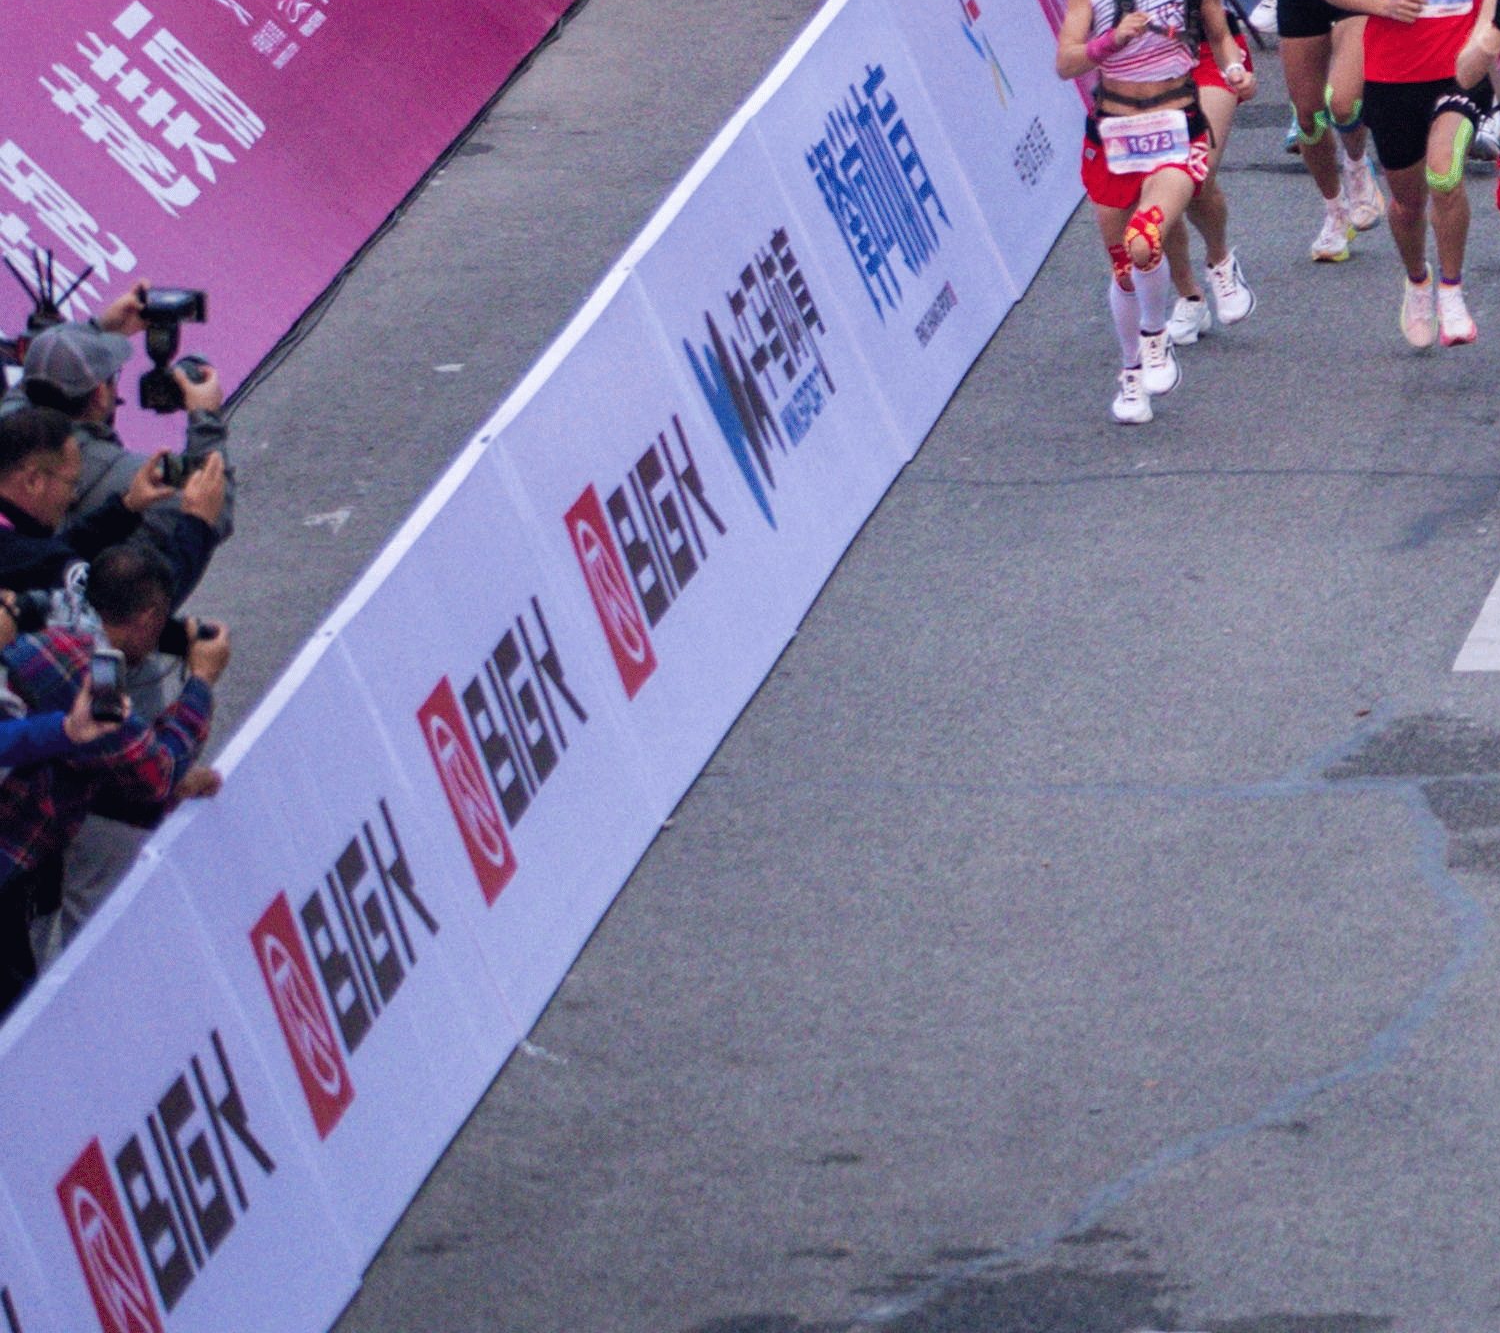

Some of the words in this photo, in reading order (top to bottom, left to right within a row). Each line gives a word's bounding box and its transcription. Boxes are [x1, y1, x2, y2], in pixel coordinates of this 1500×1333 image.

[1128, 133, 1173, 153] 1673
[605, 413, 727, 631] BIGK
[463, 596, 588, 830] BIGK
[299, 797, 441, 1057] BIGK
[113, 1029, 276, 1315] BIGK
